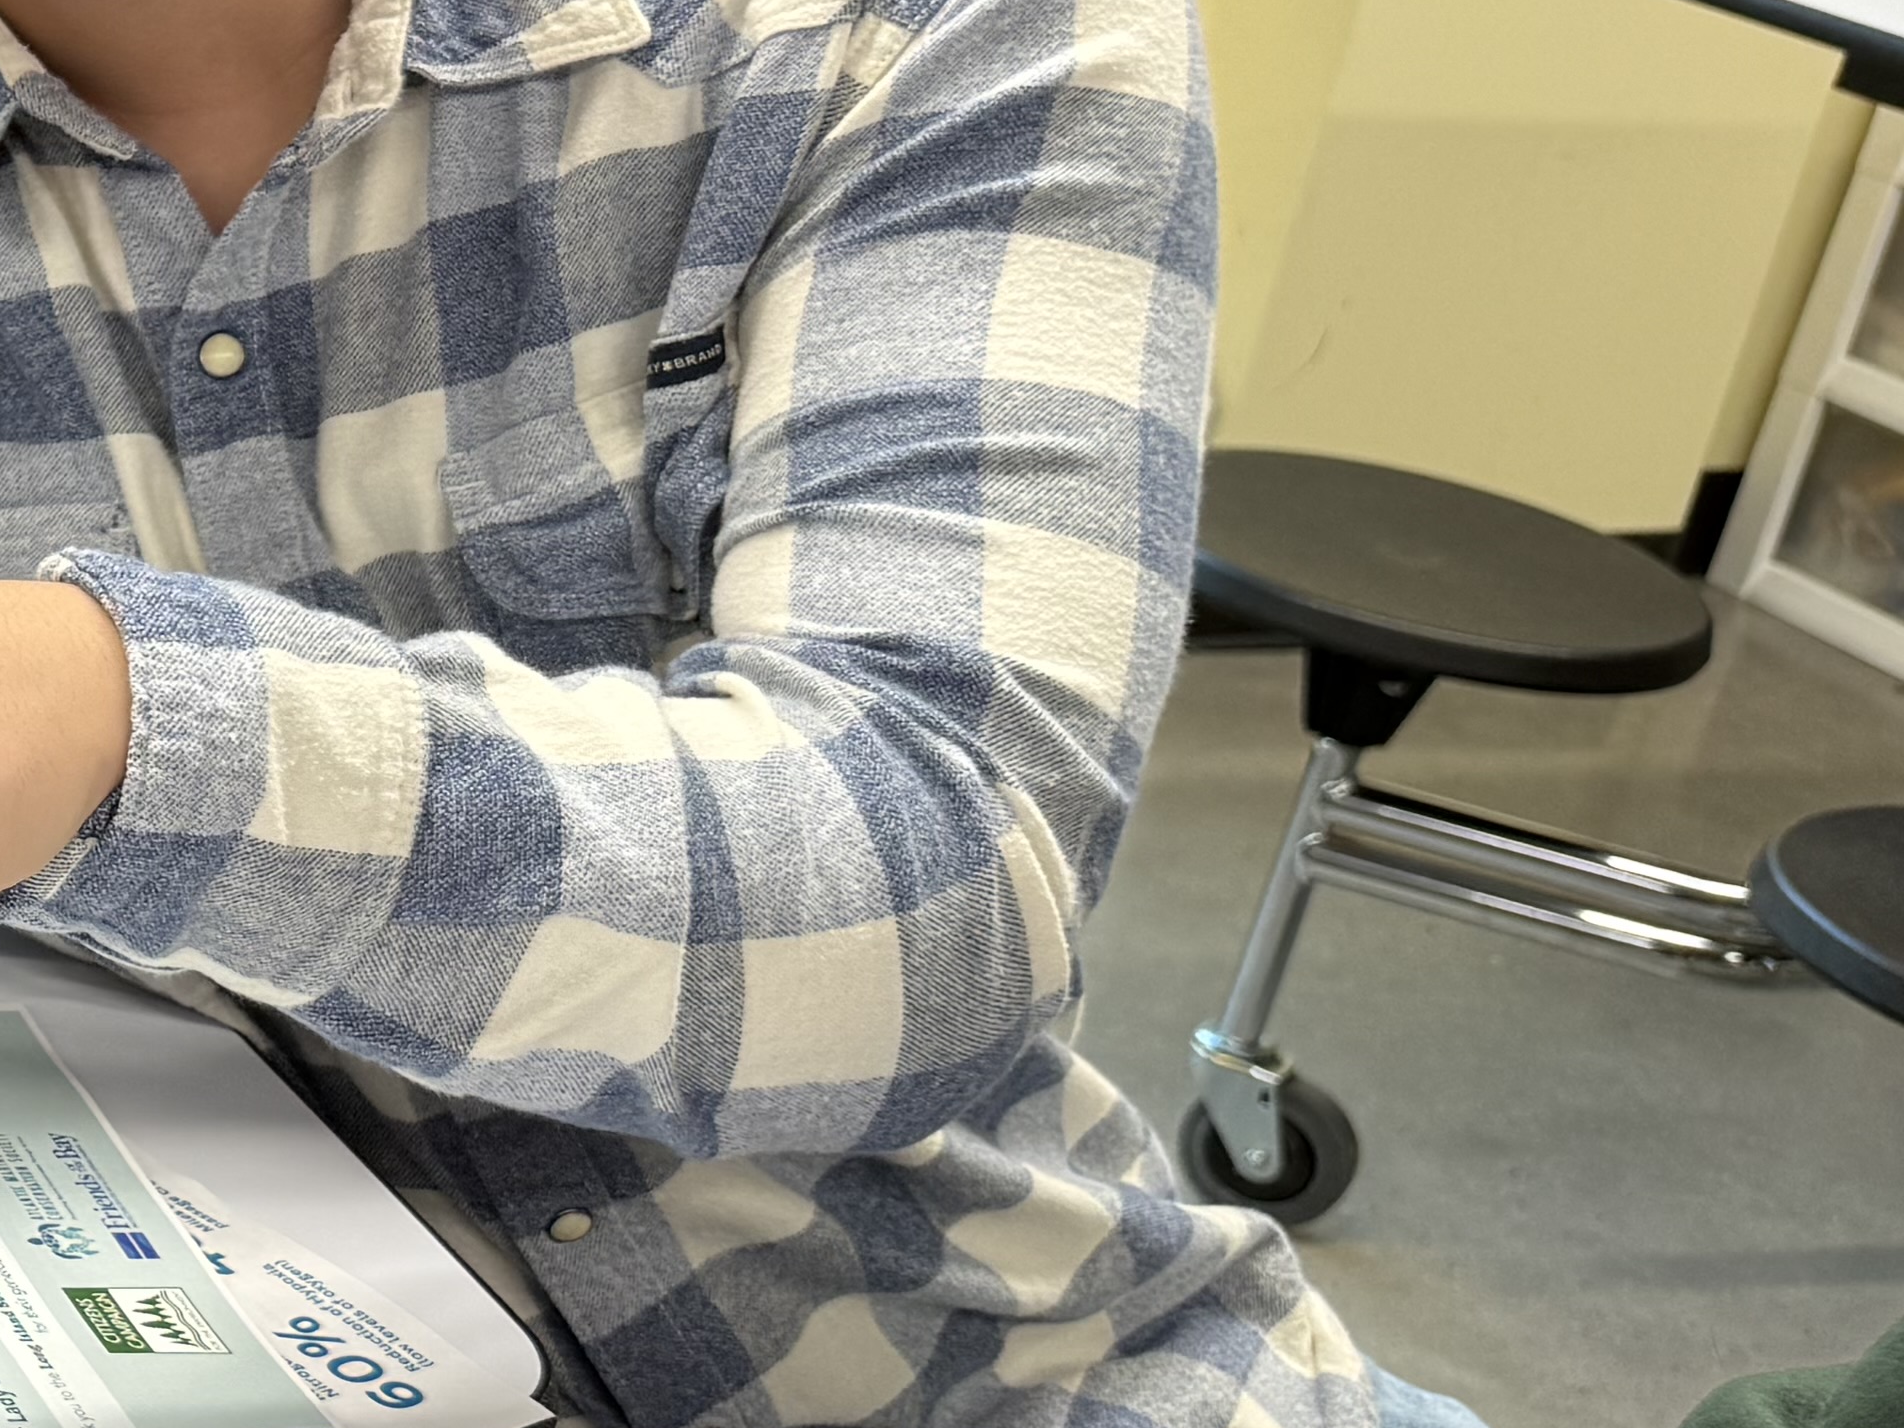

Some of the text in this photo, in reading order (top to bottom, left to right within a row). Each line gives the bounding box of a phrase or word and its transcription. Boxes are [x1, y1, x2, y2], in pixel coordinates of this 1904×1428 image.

[47, 1132, 82, 1159] Bay
[74, 1173, 131, 1230] Friends
[1, 1309, 34, 1342] Island
[75, 1298, 121, 1344] CITIZENS
[91, 1292, 145, 1349] CAMPAIGN
[262, 1263, 421, 1373] Reduction of Hypoxia
[273, 1258, 435, 1369] (low levels of oxygen)
[27, 1343, 54, 1370] Long
[271, 1315, 424, 1409] 60%
[47, 1371, 66, 1389] the
[61, 1390, 76, 1401] to
[73, 1403, 95, 1424] you
